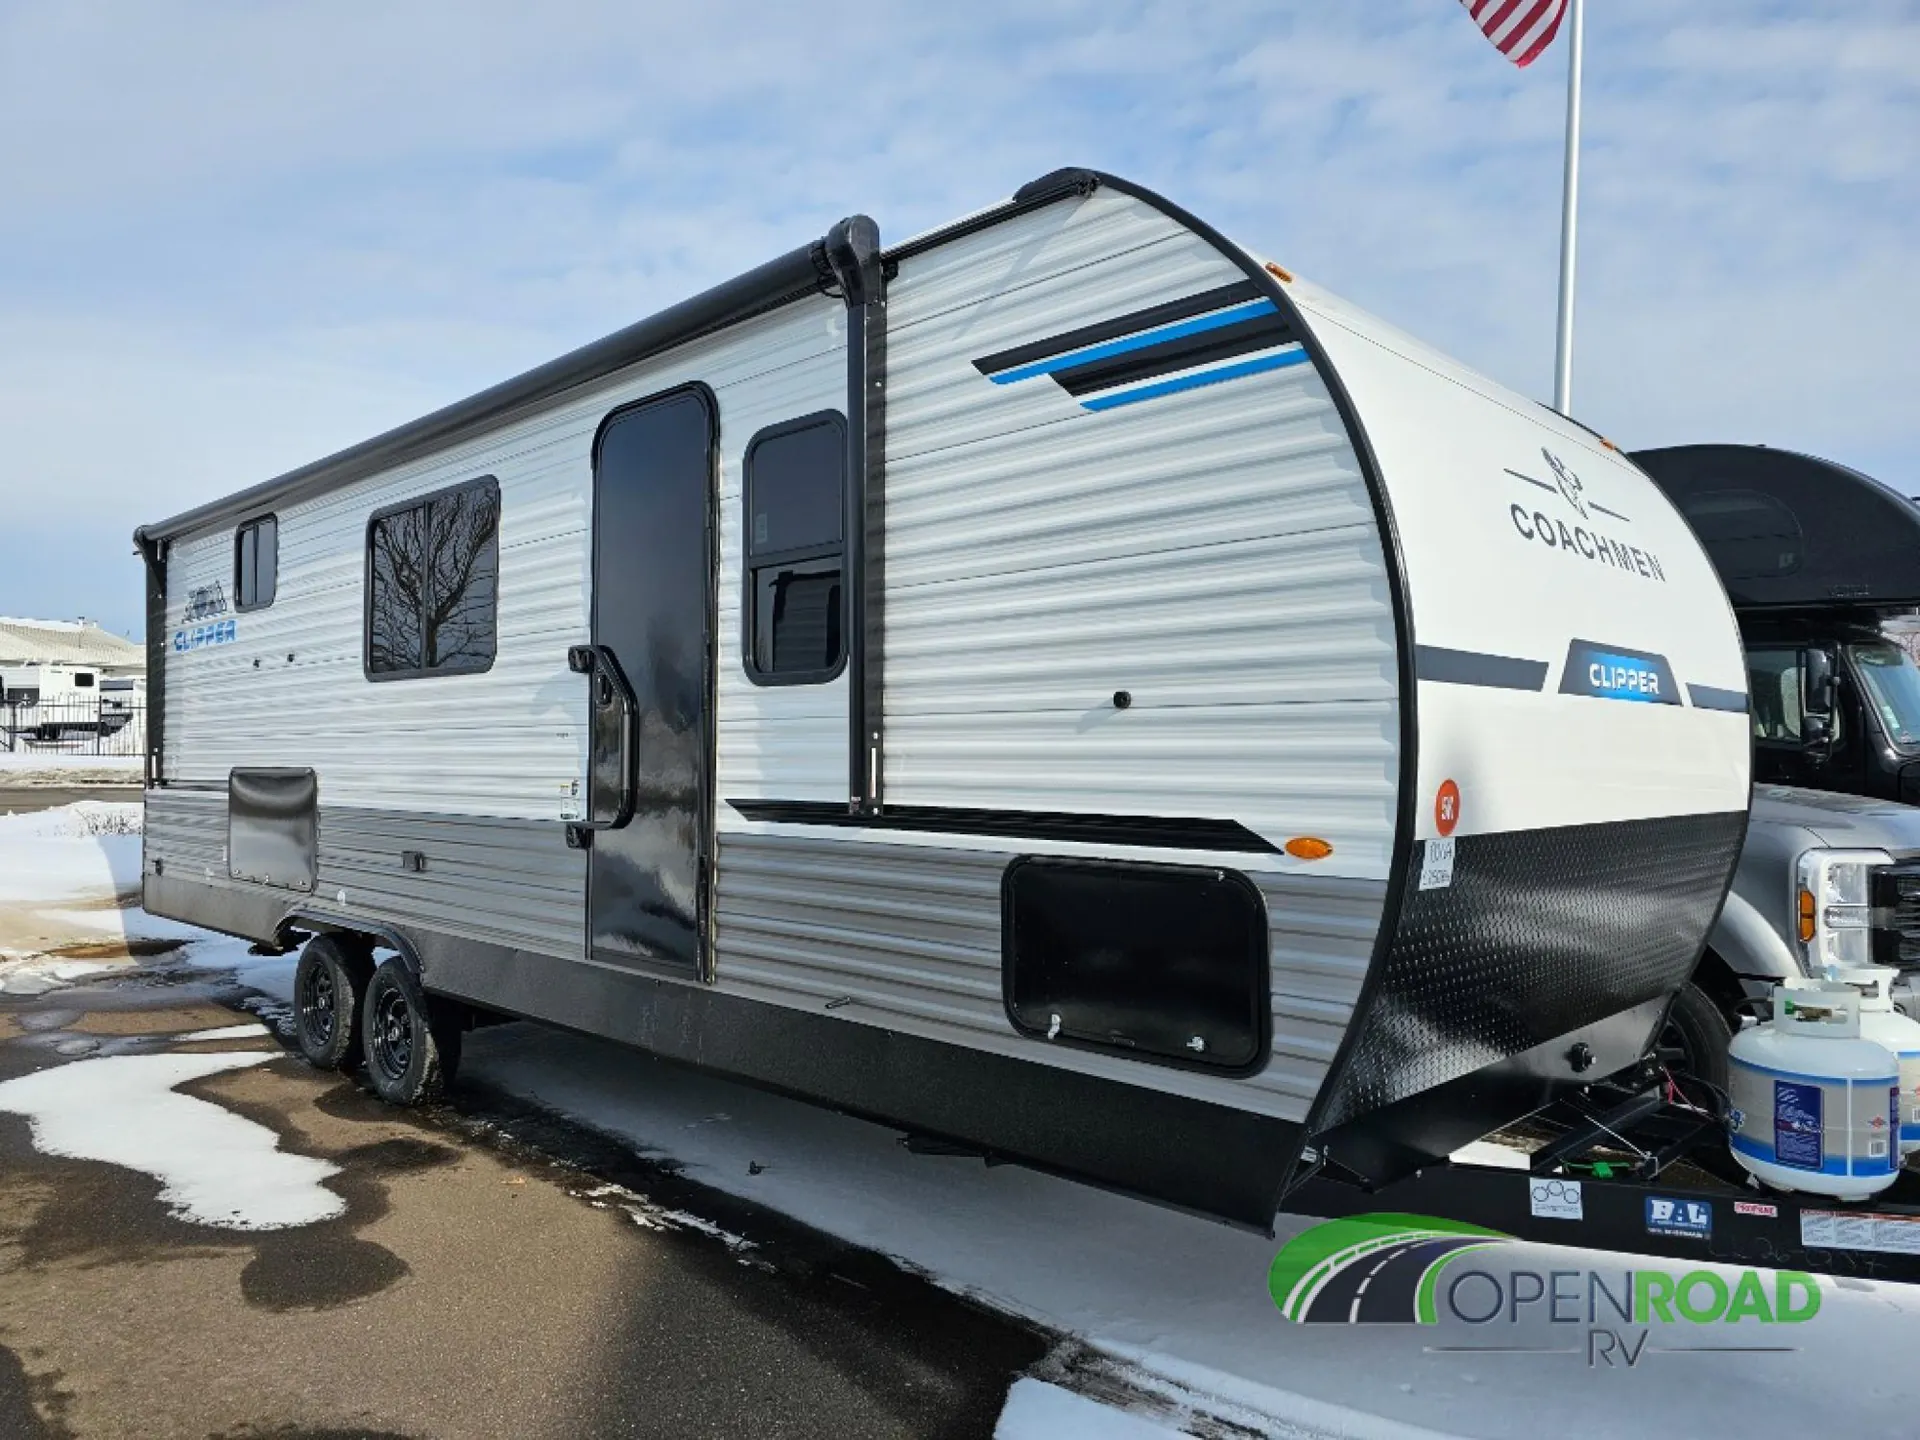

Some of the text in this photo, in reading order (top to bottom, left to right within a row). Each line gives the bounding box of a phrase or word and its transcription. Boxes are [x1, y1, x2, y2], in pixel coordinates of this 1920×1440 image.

[1511, 503, 1666, 582] COACHMEN
[174, 620, 235, 651] CLIPPER
[1589, 663, 1660, 694] CLIPPER
